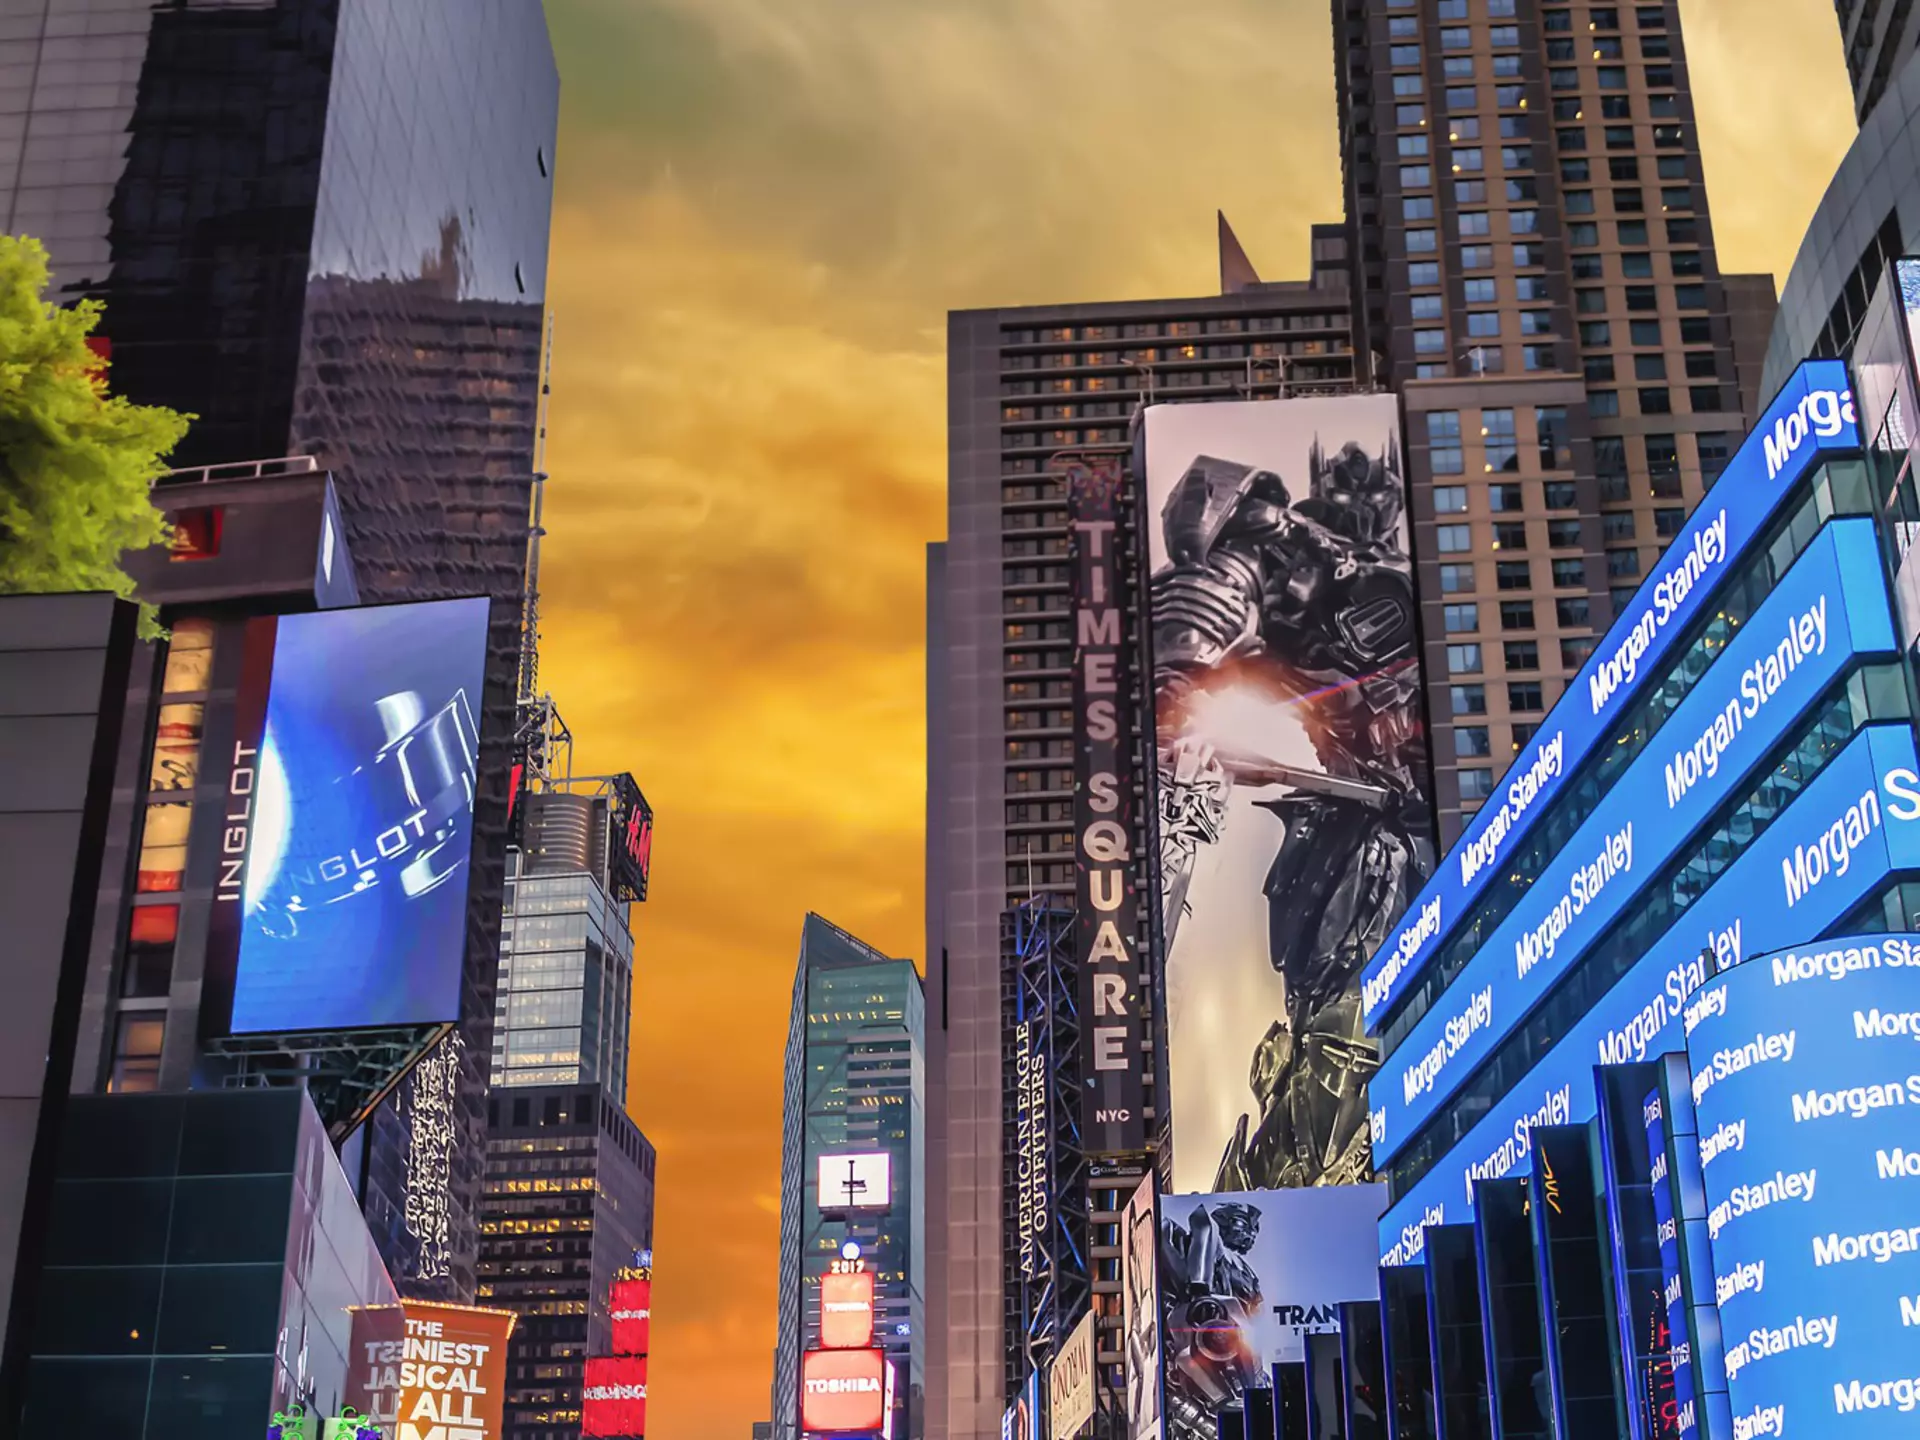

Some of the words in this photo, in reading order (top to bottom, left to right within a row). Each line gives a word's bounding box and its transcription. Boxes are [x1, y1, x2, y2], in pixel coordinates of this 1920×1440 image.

[1074, 520, 1121, 741] TIMES
[1589, 609, 1656, 715] Morgan
[1653, 508, 1726, 627] Stanley
[1665, 697, 1743, 809] Morgan
[1740, 593, 1826, 719] Stanley
[218, 740, 257, 901] INGLOT
[280, 808, 428, 891] NGLOT
[1460, 804, 1512, 887] Morgan
[1508, 730, 1563, 822] Stanley
[1781, 789, 1880, 909] Morgan
[1083, 772, 1129, 1070] SQUARE
[1515, 894, 1573, 981] Morgan
[1569, 820, 1633, 916] Stanley
[1361, 950, 1402, 1017] Morgan
[1398, 894, 1441, 967] Stanley
[1771, 945, 1882, 987] Morgan
[1016, 1020, 1030, 1109] EAGLE
[1402, 1039, 1447, 1106] Morgan
[1444, 984, 1493, 1058] Stanley
[1598, 992, 1668, 1066] Morgan
[1712, 1029, 1796, 1081] Stanley
[1032, 1053, 1048, 1233] OUTFITTERS
[1095, 1108, 1131, 1123] NYC
[1791, 1081, 1905, 1124] Morgan
[1018, 1118, 1034, 1278] AMERICAN
[1730, 1168, 1817, 1218] Stanley
[824, 1302, 870, 1313] TOSHIBA
[831, 1261, 865, 1275] 2017
[404, 1319, 444, 1338] THE
[1749, 1314, 1838, 1361] Stanley
[409, 1391, 485, 1427] ALL
[806, 1378, 882, 1394] TOSHIBA
